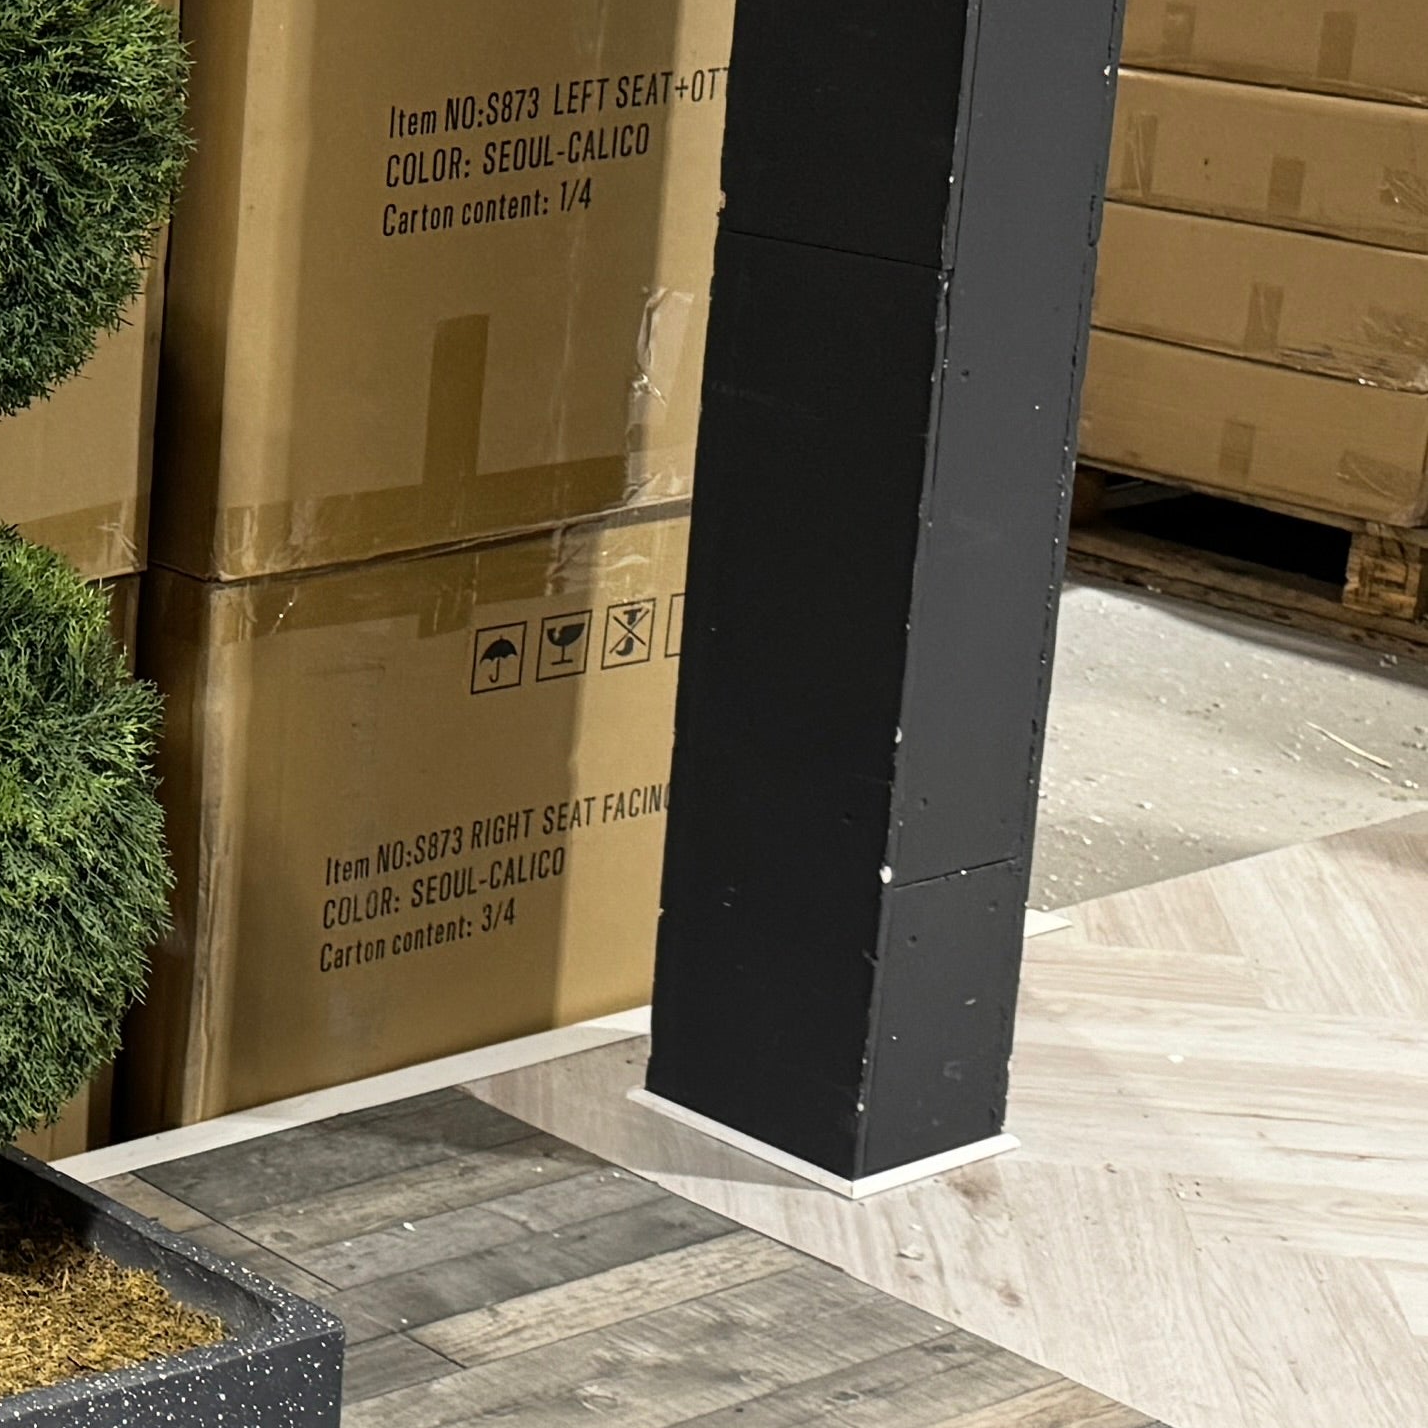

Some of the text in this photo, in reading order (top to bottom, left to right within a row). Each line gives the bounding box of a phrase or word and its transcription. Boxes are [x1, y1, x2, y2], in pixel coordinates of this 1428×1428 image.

[389, 104, 436, 139] Item
[553, 78, 609, 116] LEFT
[616, 67, 728, 109] SEAT+OT
[385, 122, 649, 189] COLOR: SEOUL-CALICO
[382, 178, 592, 237] Carton content: 1/4
[325, 855, 370, 887] Item
[470, 808, 535, 850] RIGHT
[543, 797, 597, 836] SEAT
[323, 846, 565, 930] COLOR: SEOUL-CALICO
[320, 898, 515, 973] Carton content: 3/4
